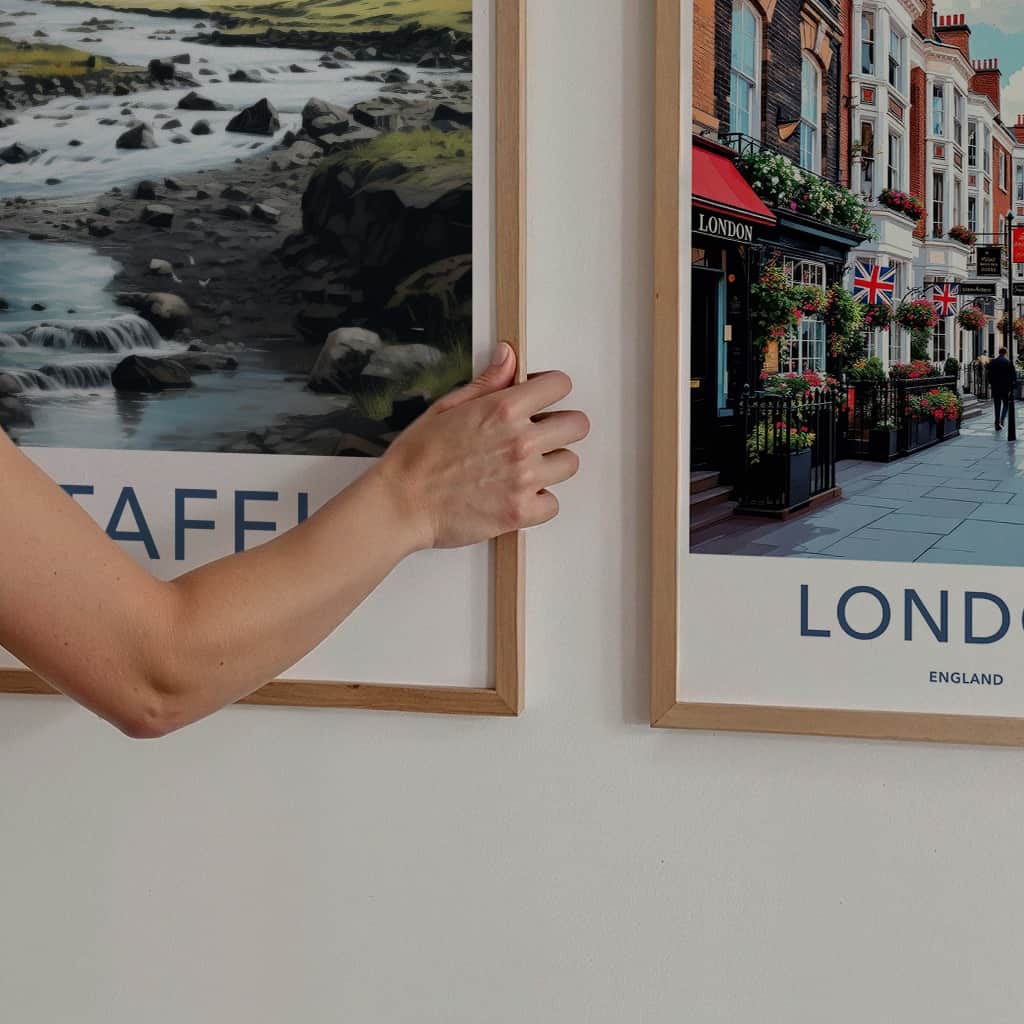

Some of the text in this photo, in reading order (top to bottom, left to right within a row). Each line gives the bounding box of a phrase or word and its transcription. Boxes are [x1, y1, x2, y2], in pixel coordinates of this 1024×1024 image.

[698, 213, 753, 242] LONDON
[800, 583, 1024, 645] LOND
[929, 671, 1004, 686] ENGLAND
